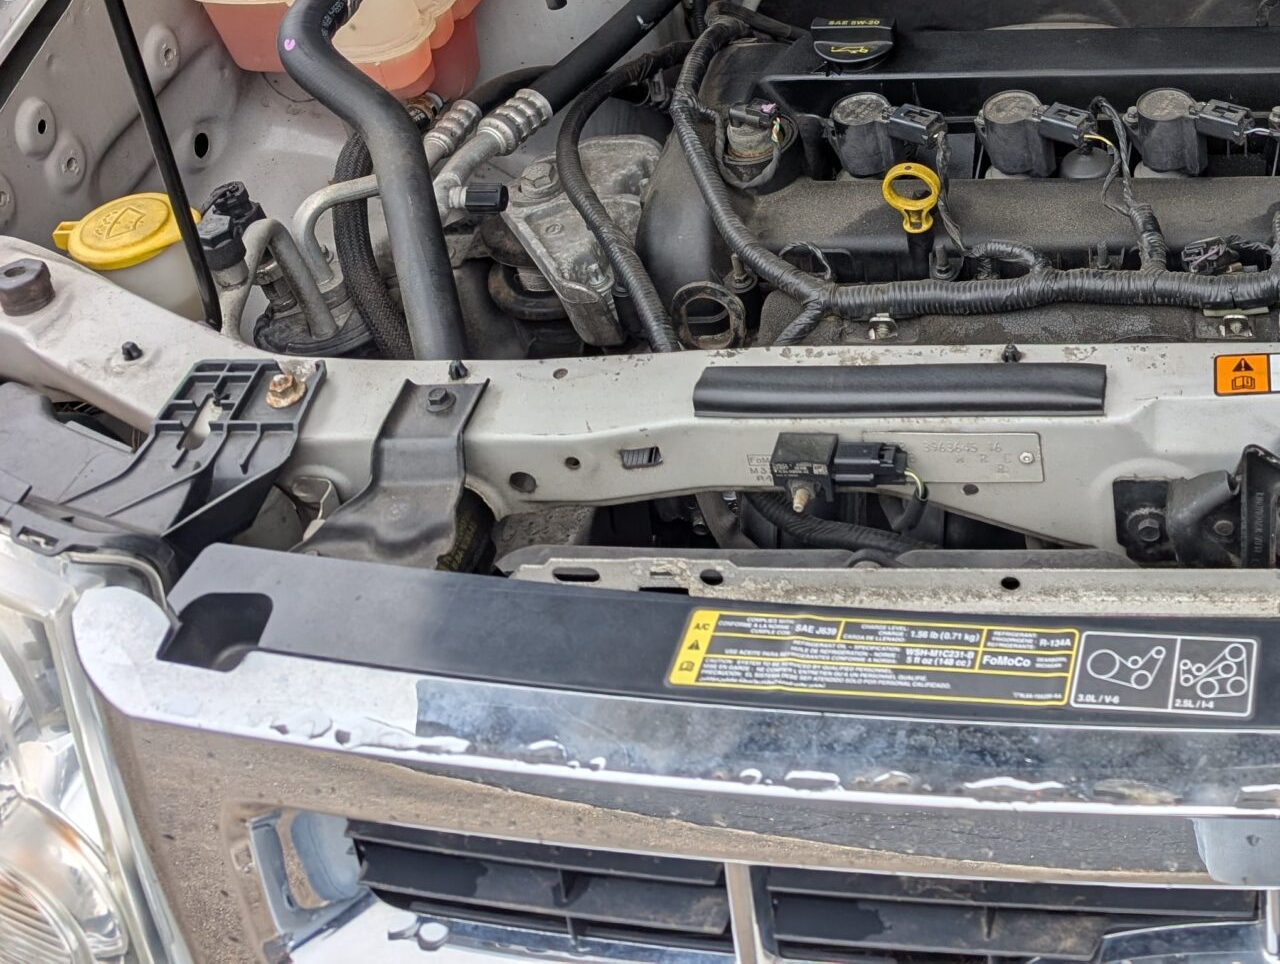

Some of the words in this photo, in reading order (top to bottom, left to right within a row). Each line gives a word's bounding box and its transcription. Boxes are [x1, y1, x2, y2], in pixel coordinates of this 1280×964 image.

[694, 622, 710, 631] A/C
[795, 624, 814, 634] SAE
[815, 626, 837, 635] J639
[940, 631, 963, 641] (0.71
[964, 632, 979, 643] kg)
[1039, 638, 1071, 647] R-134A
[982, 655, 1031, 667] FoMoCo
[1077, 694, 1096, 703] 3.0L
[1105, 695, 1120, 704] V-6
[1174, 699, 1194, 708] 2.5L
